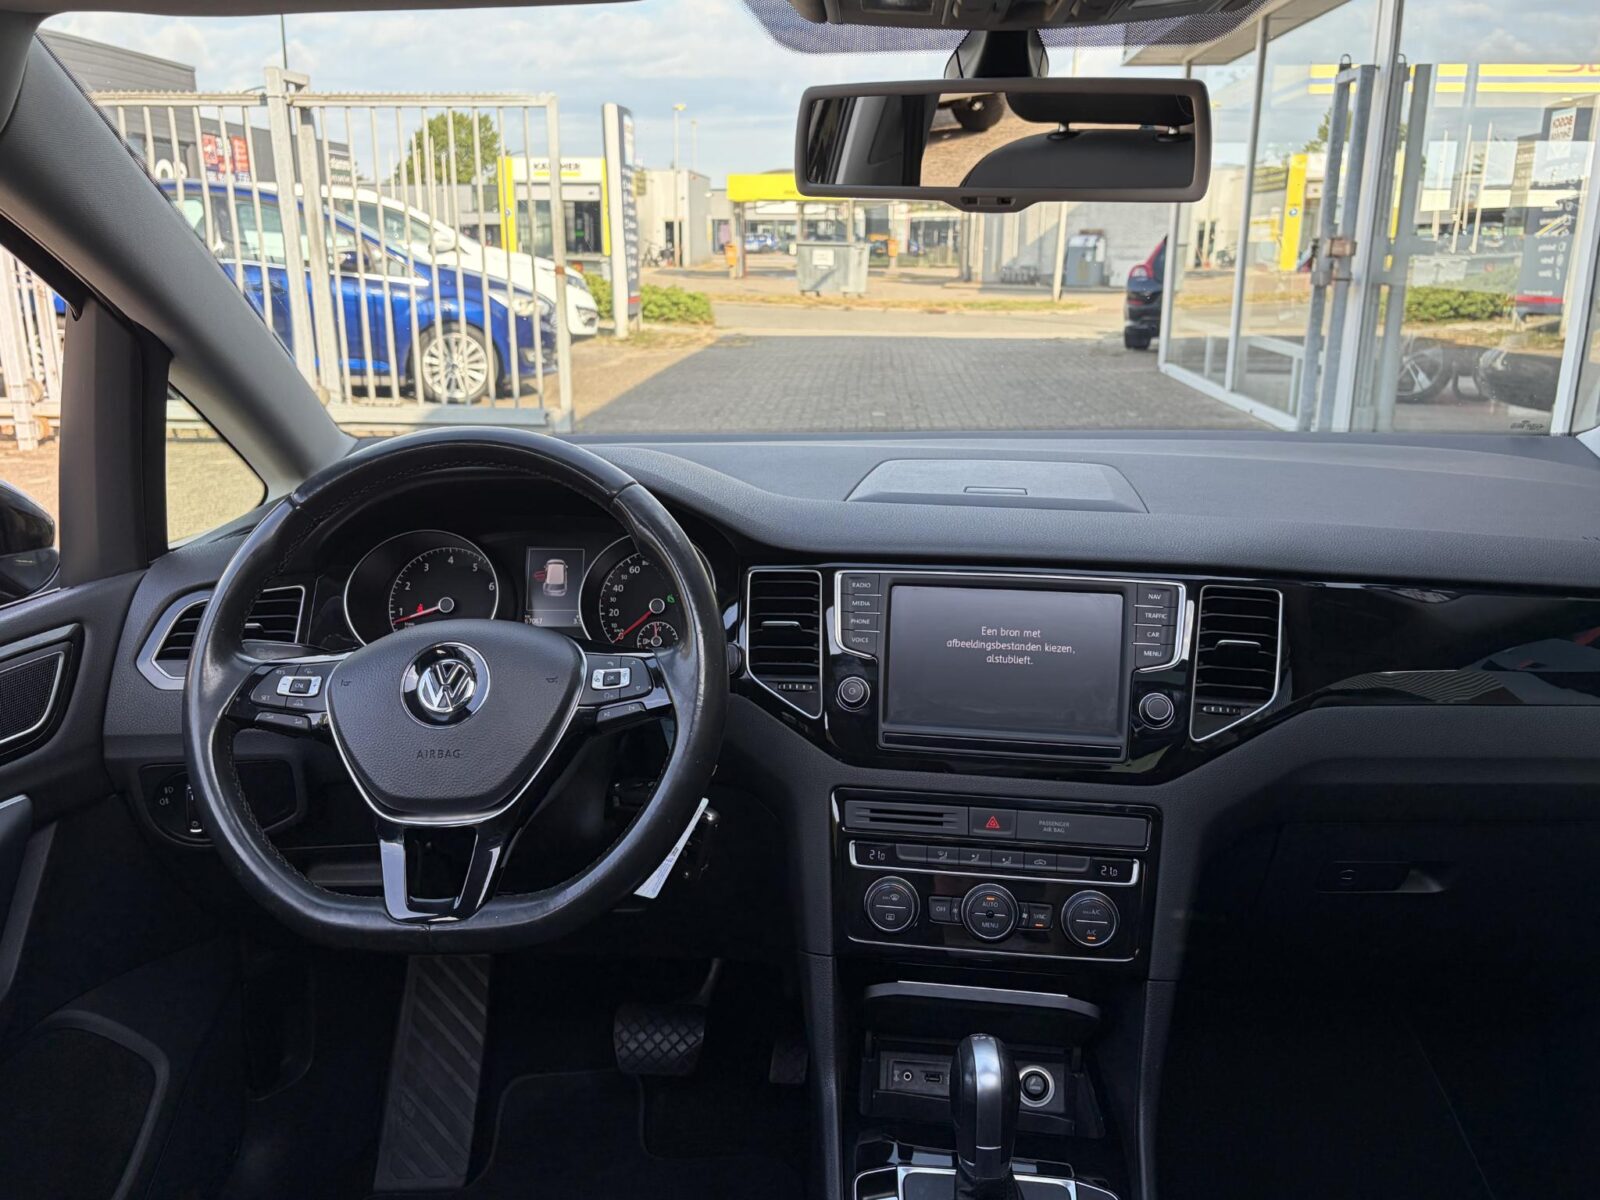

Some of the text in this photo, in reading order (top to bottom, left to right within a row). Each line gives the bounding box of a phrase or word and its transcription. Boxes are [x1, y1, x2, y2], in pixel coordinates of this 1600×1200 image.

[447, 556, 454, 565] 4
[423, 563, 430, 572] 3
[472, 563, 478, 572] 5
[629, 566, 641, 575] 60
[404, 582, 411, 591] 2
[488, 582, 495, 591] 6
[612, 584, 624, 593] 40
[608, 609, 620, 617] 20
[1145, 612, 1168, 620] TRAFFIC
[981, 625, 1041, 638] Een bron met
[946, 638, 1076, 655] afbeeldingsbestanden kiezen,
[986, 654, 1034, 666] alstublieft.
[417, 749, 461, 759] AIRBAG
[1039, 820, 1070, 828] PASSENGER
